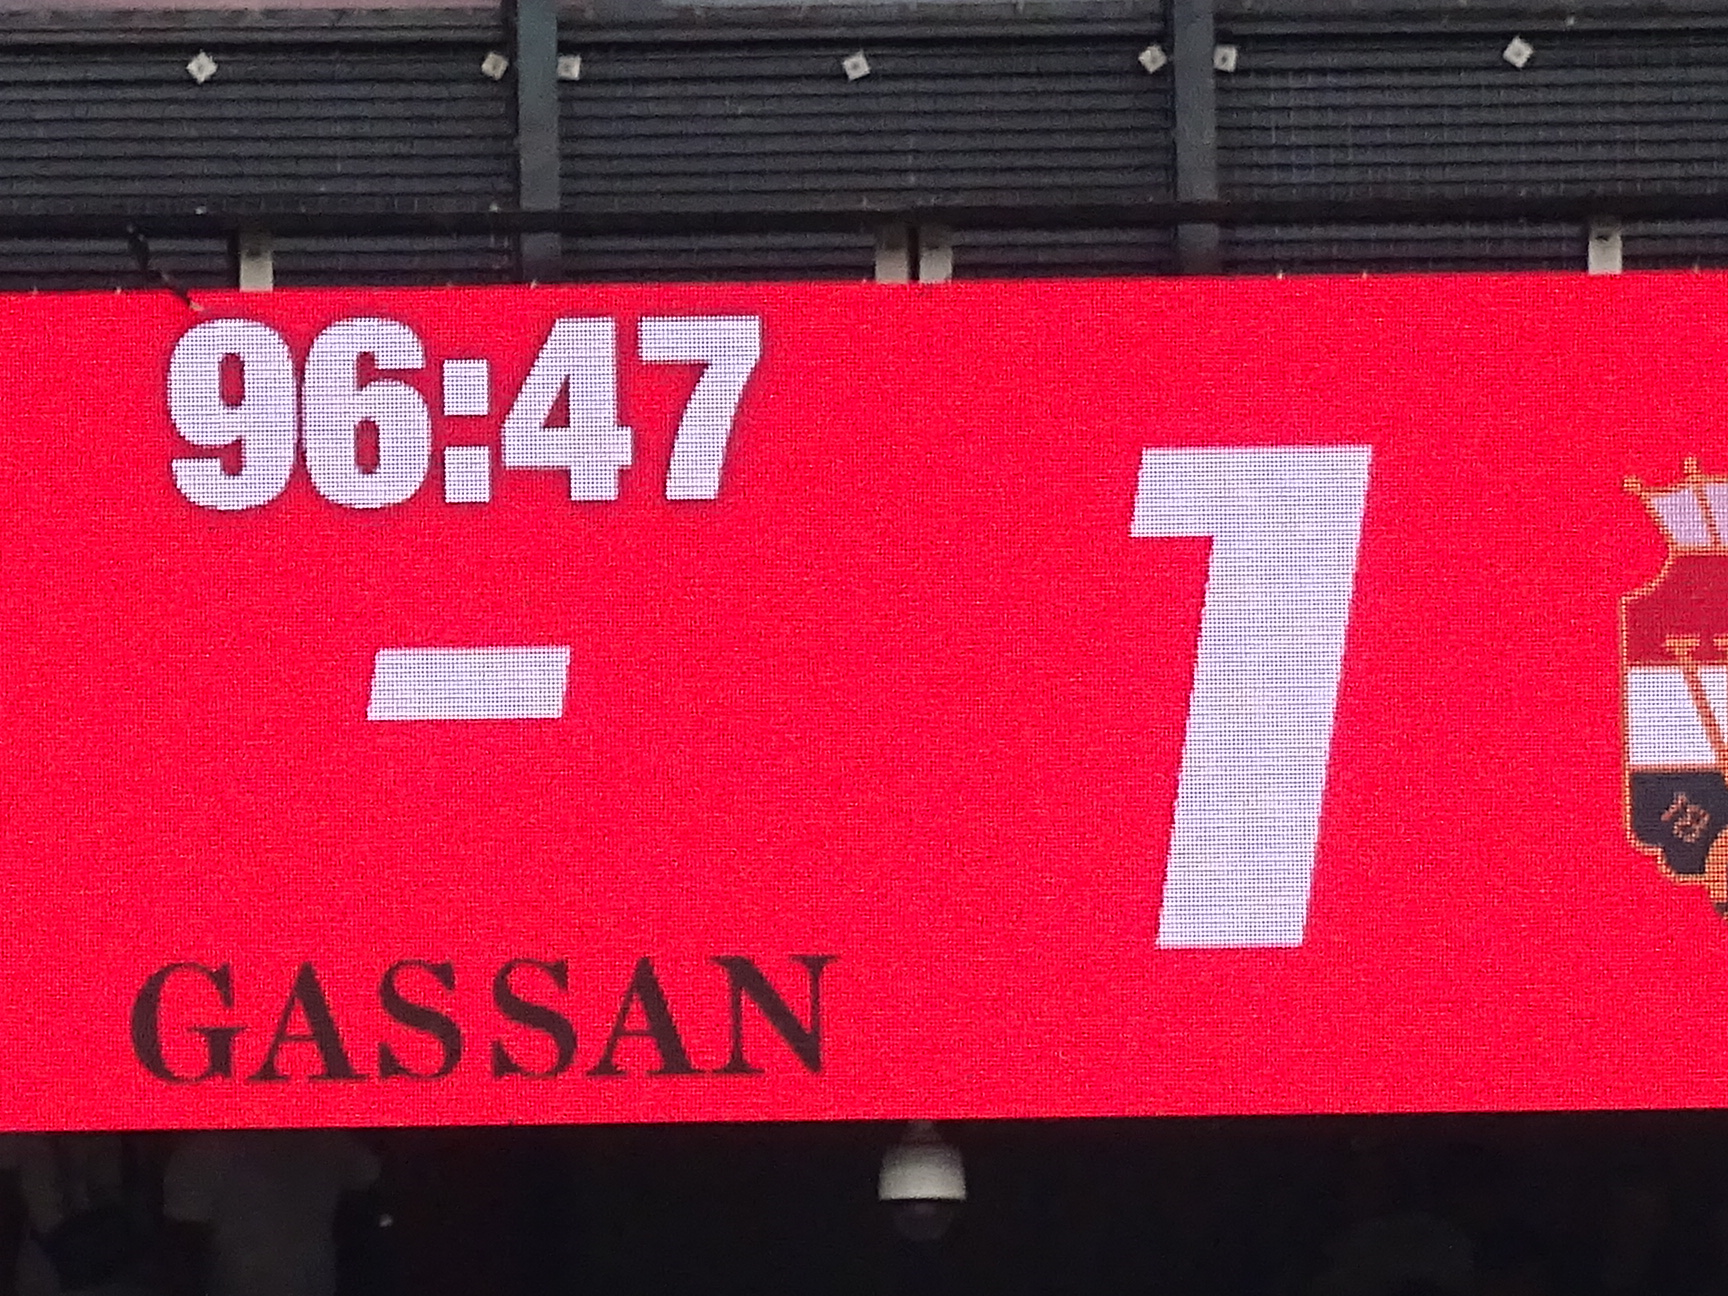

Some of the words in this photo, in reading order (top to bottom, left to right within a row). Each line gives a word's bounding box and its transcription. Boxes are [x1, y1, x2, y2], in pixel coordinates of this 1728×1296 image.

[166, 315, 763, 511] 96:47
[1129, 444, 1373, 949] 1
[129, 954, 841, 1085] GASSAN
